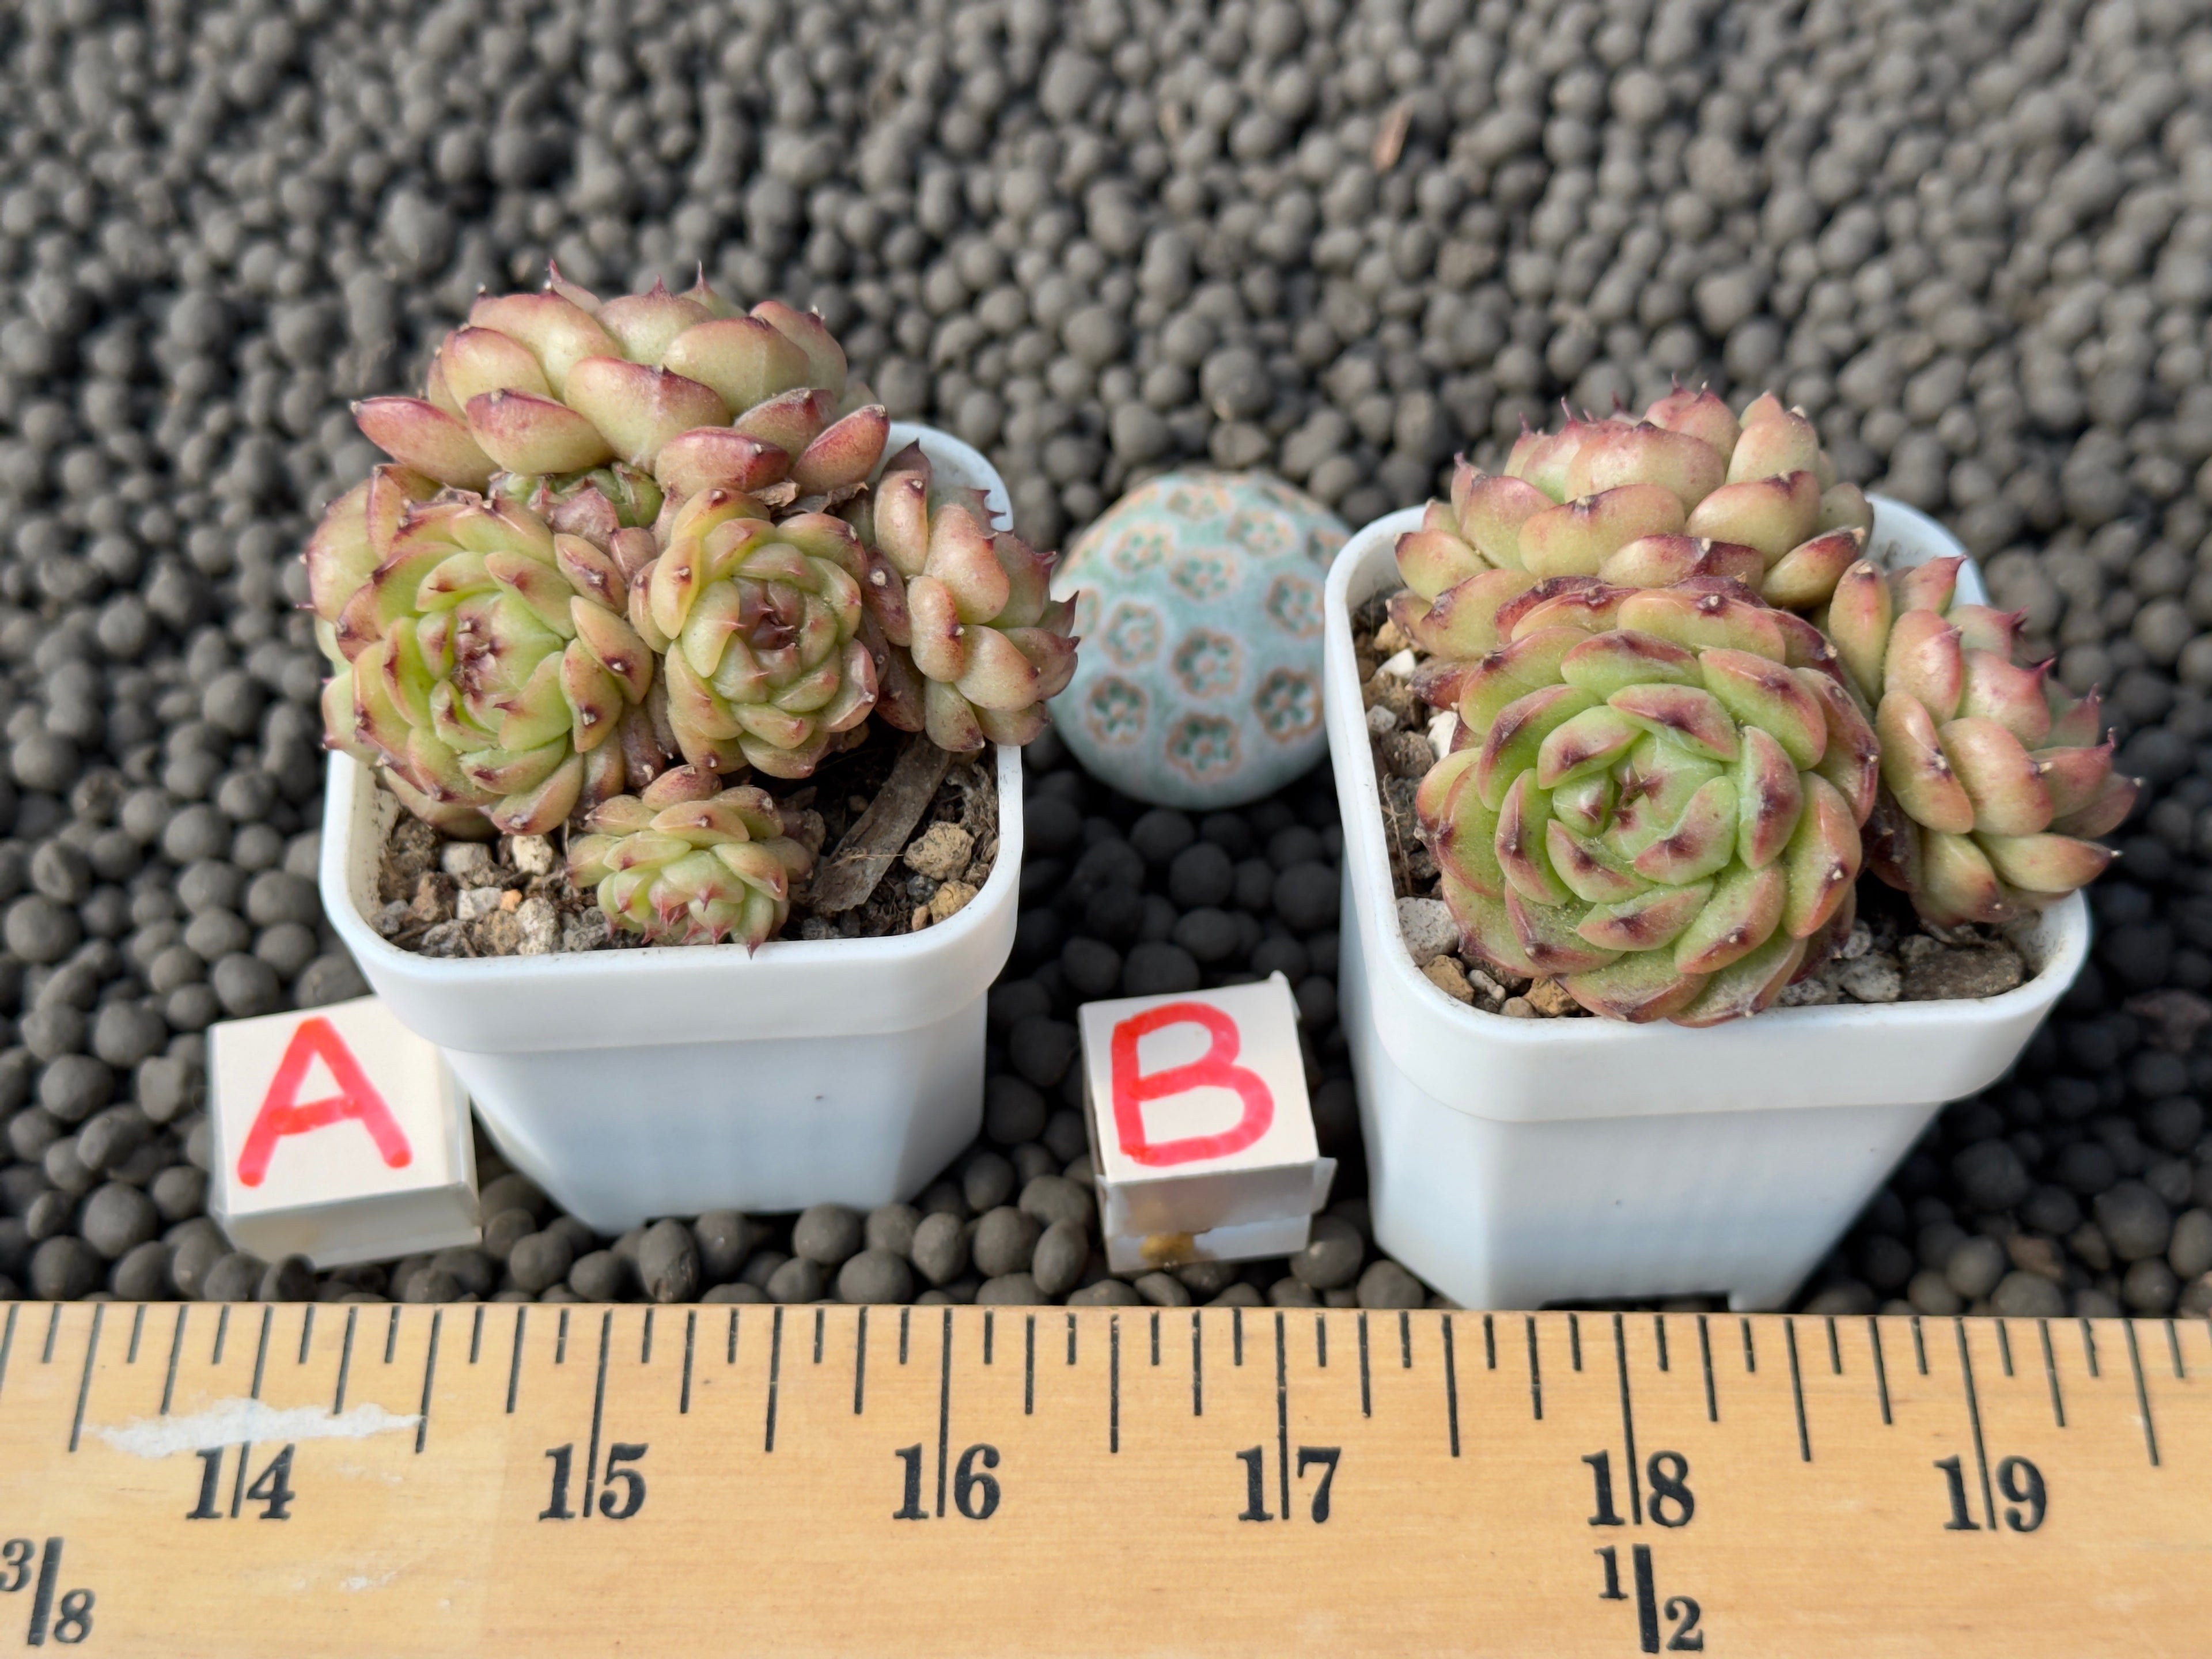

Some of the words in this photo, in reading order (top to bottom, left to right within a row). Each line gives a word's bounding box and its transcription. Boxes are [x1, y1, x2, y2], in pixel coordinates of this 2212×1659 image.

[236, 1016, 413, 1188] A
[1110, 1001, 1275, 1168] B
[185, 1443, 296, 1521] 14
[537, 1442, 649, 1521] 15
[892, 1444, 1001, 1521] 16
[1236, 1445, 1342, 1524] 17
[1581, 1450, 1695, 1529] 18
[1934, 1455, 2048, 1533] 19
